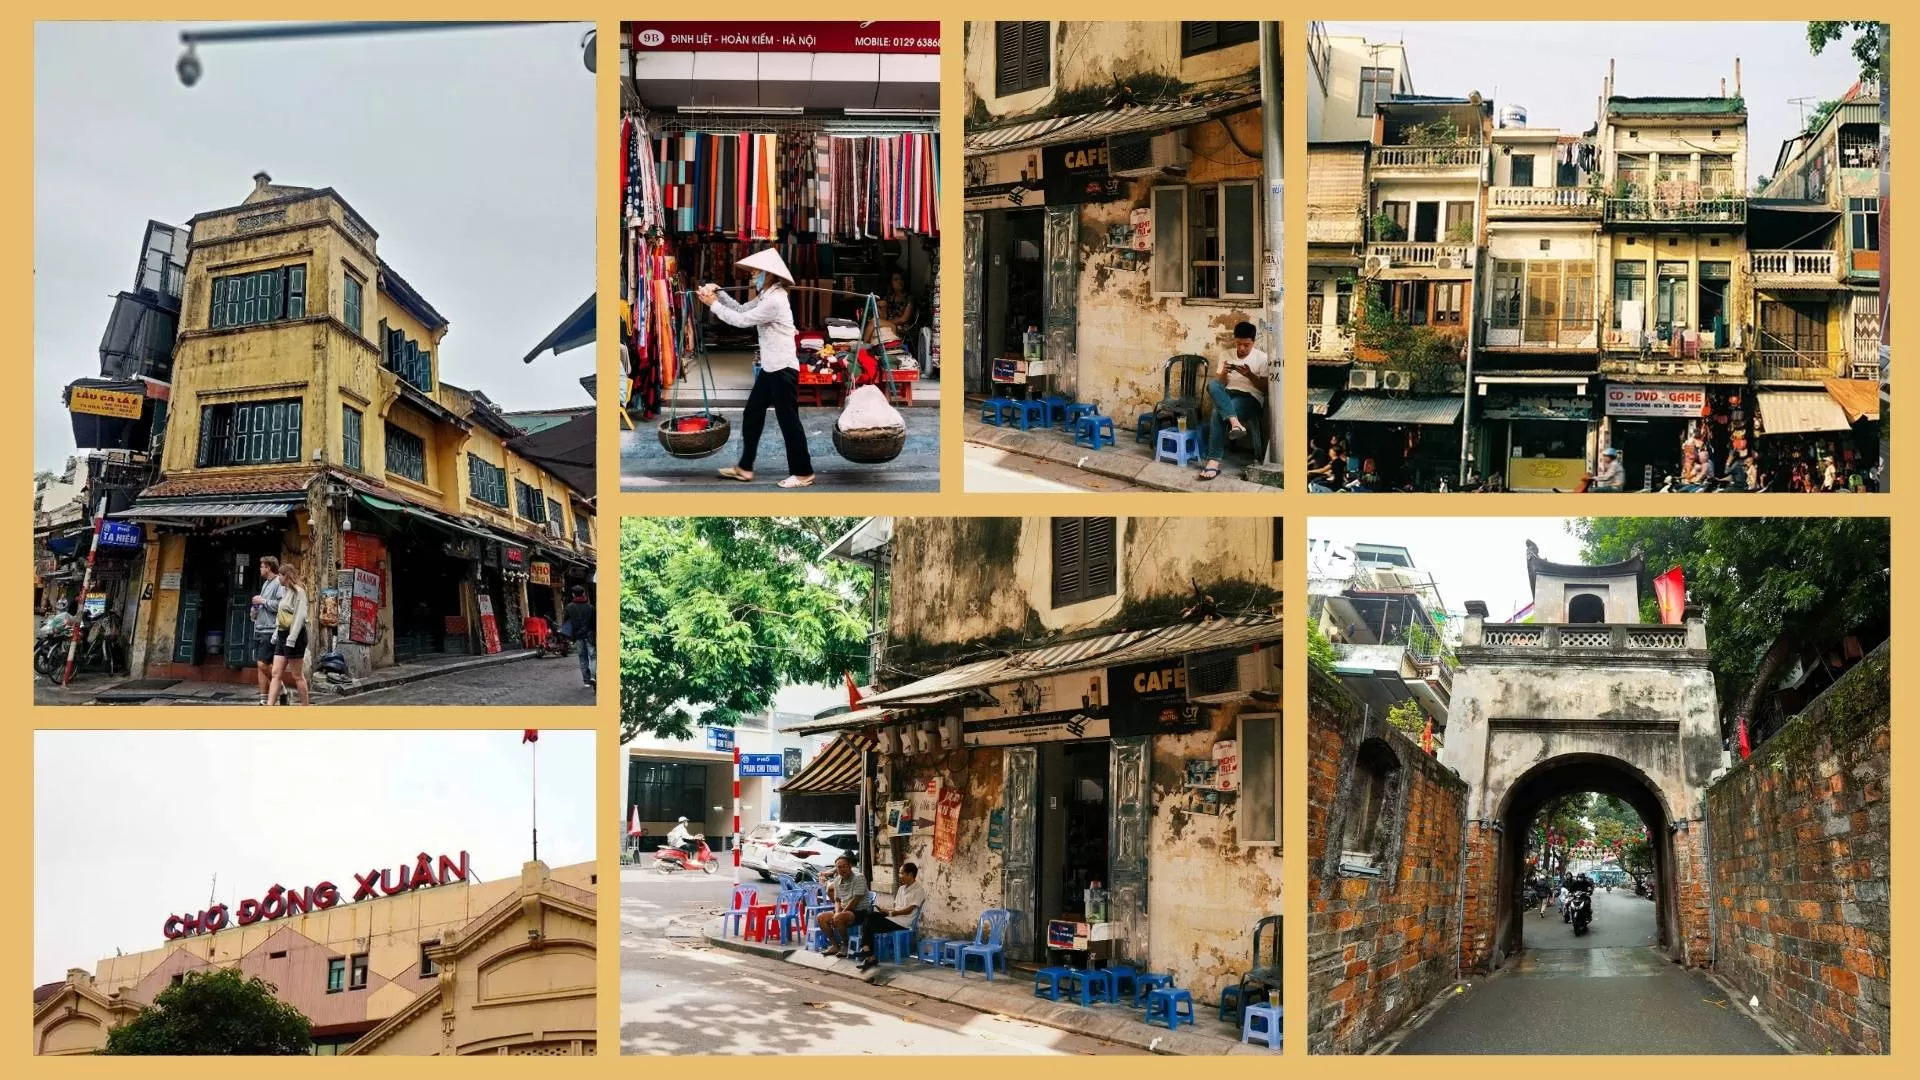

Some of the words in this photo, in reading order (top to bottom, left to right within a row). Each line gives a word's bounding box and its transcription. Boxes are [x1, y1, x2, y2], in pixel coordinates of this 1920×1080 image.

[644, 33, 660, 43] 9B
[696, 32, 713, 46] LIỆT
[752, 32, 774, 45] KIẾM
[783, 33, 796, 45] HÀ
[799, 33, 816, 47] NỘI
[855, 37, 891, 46] MOBILE:
[893, 37, 915, 47] 0129
[1609, 391, 1624, 401] CD
[1634, 391, 1658, 401] DVD
[1669, 392, 1702, 402] GAME
[163, 902, 229, 940] CHỢ
[236, 881, 341, 926] ĐỒNG
[352, 850, 470, 902] XUÂN
